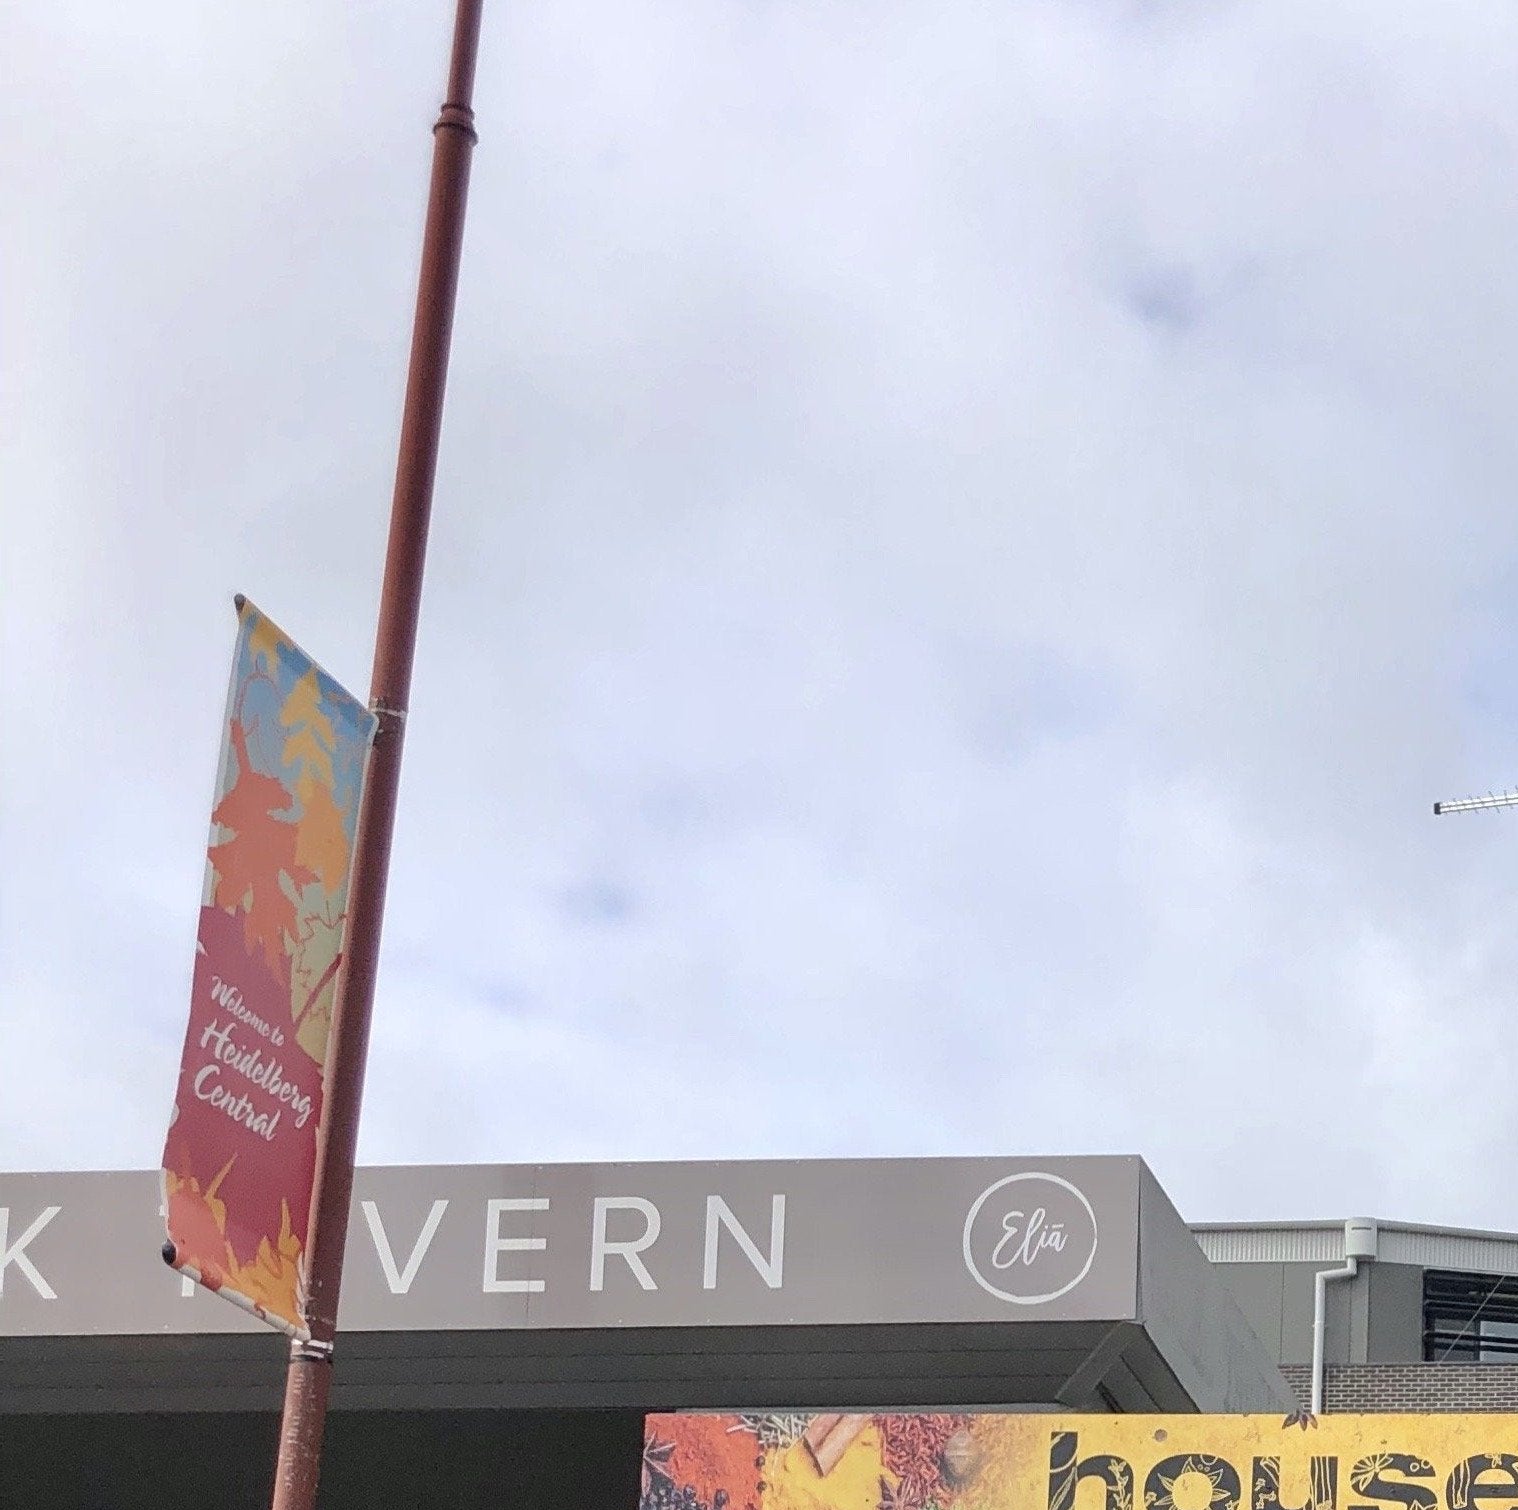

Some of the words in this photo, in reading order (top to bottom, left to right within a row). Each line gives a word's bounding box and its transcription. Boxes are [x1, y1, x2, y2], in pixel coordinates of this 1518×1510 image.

[211, 975, 270, 1036] Welcome
[270, 1025, 285, 1047] to
[193, 1064, 282, 1142] Central
[200, 1018, 314, 1129] Heidelberg
